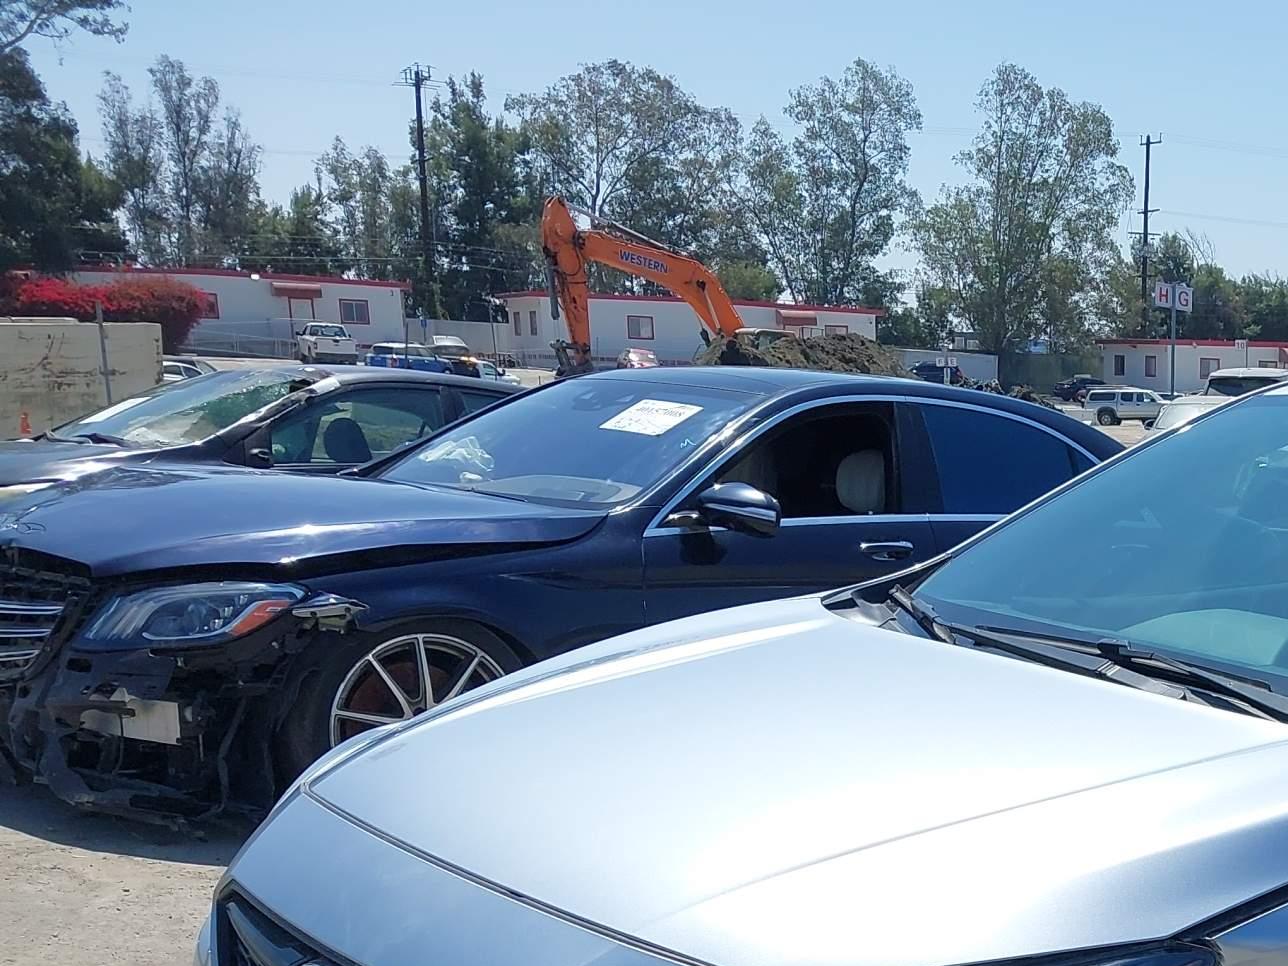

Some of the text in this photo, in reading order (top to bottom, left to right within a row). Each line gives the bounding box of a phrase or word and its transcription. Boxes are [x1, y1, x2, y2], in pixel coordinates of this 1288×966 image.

[619, 249, 668, 273] WESTERN
[1159, 287, 1169, 303] H
[1178, 291, 1189, 307] G
